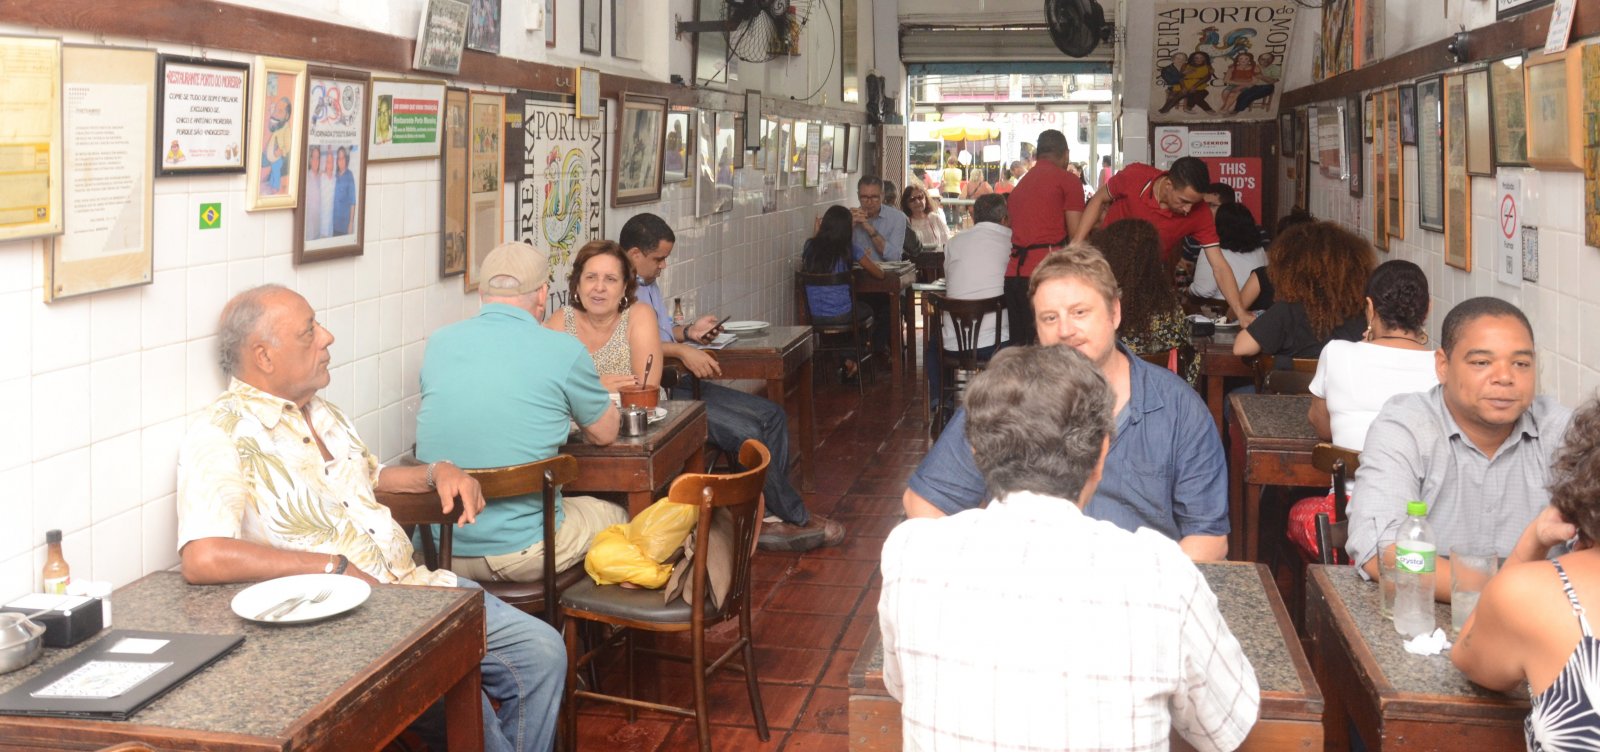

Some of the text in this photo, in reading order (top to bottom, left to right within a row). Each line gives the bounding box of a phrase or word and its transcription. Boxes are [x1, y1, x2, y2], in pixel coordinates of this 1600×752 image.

[1180, 5, 1295, 24] PORTO do
[1156, 8, 1180, 79] OREIRA
[1265, 18, 1292, 67] MORE
[167, 70, 200, 86] RESTAURANTE
[200, 72, 215, 87] PORTO
[536, 110, 591, 142] PORTO
[1219, 162, 1247, 175] THIS
